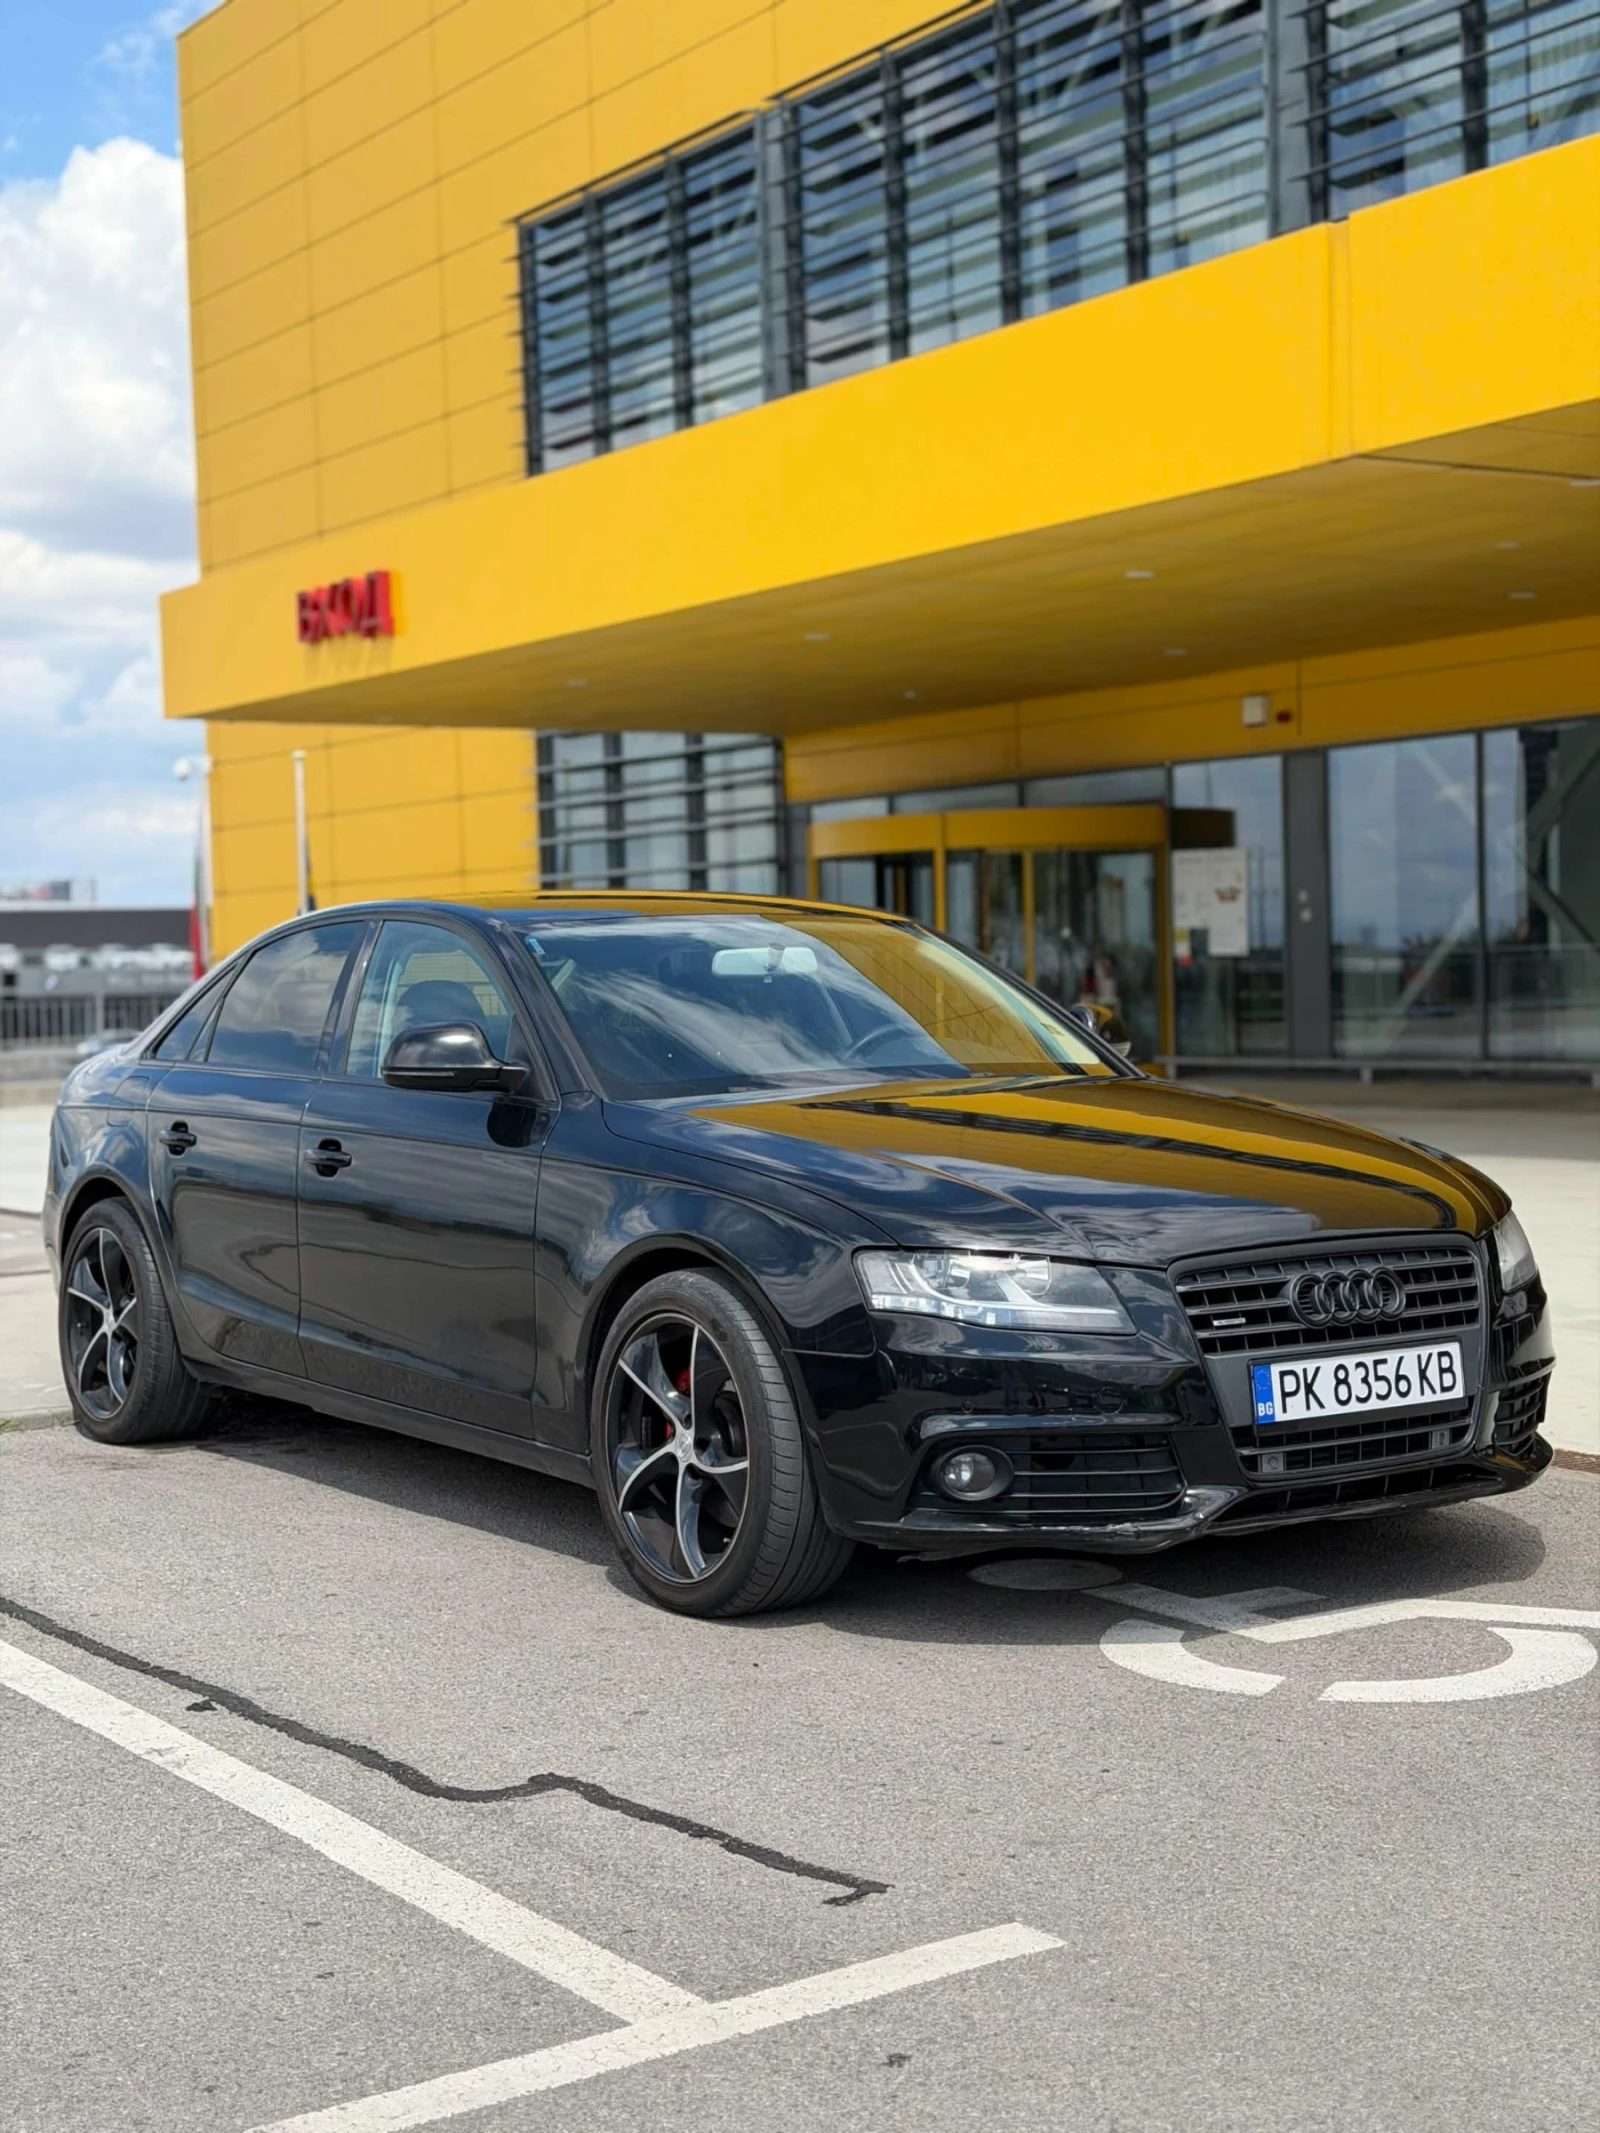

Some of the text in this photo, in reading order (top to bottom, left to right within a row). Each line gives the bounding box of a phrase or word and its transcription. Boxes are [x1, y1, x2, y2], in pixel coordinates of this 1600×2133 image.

[1278, 1350, 1457, 1414] PK 8356 KB
[1257, 1402, 1274, 1417] BG
